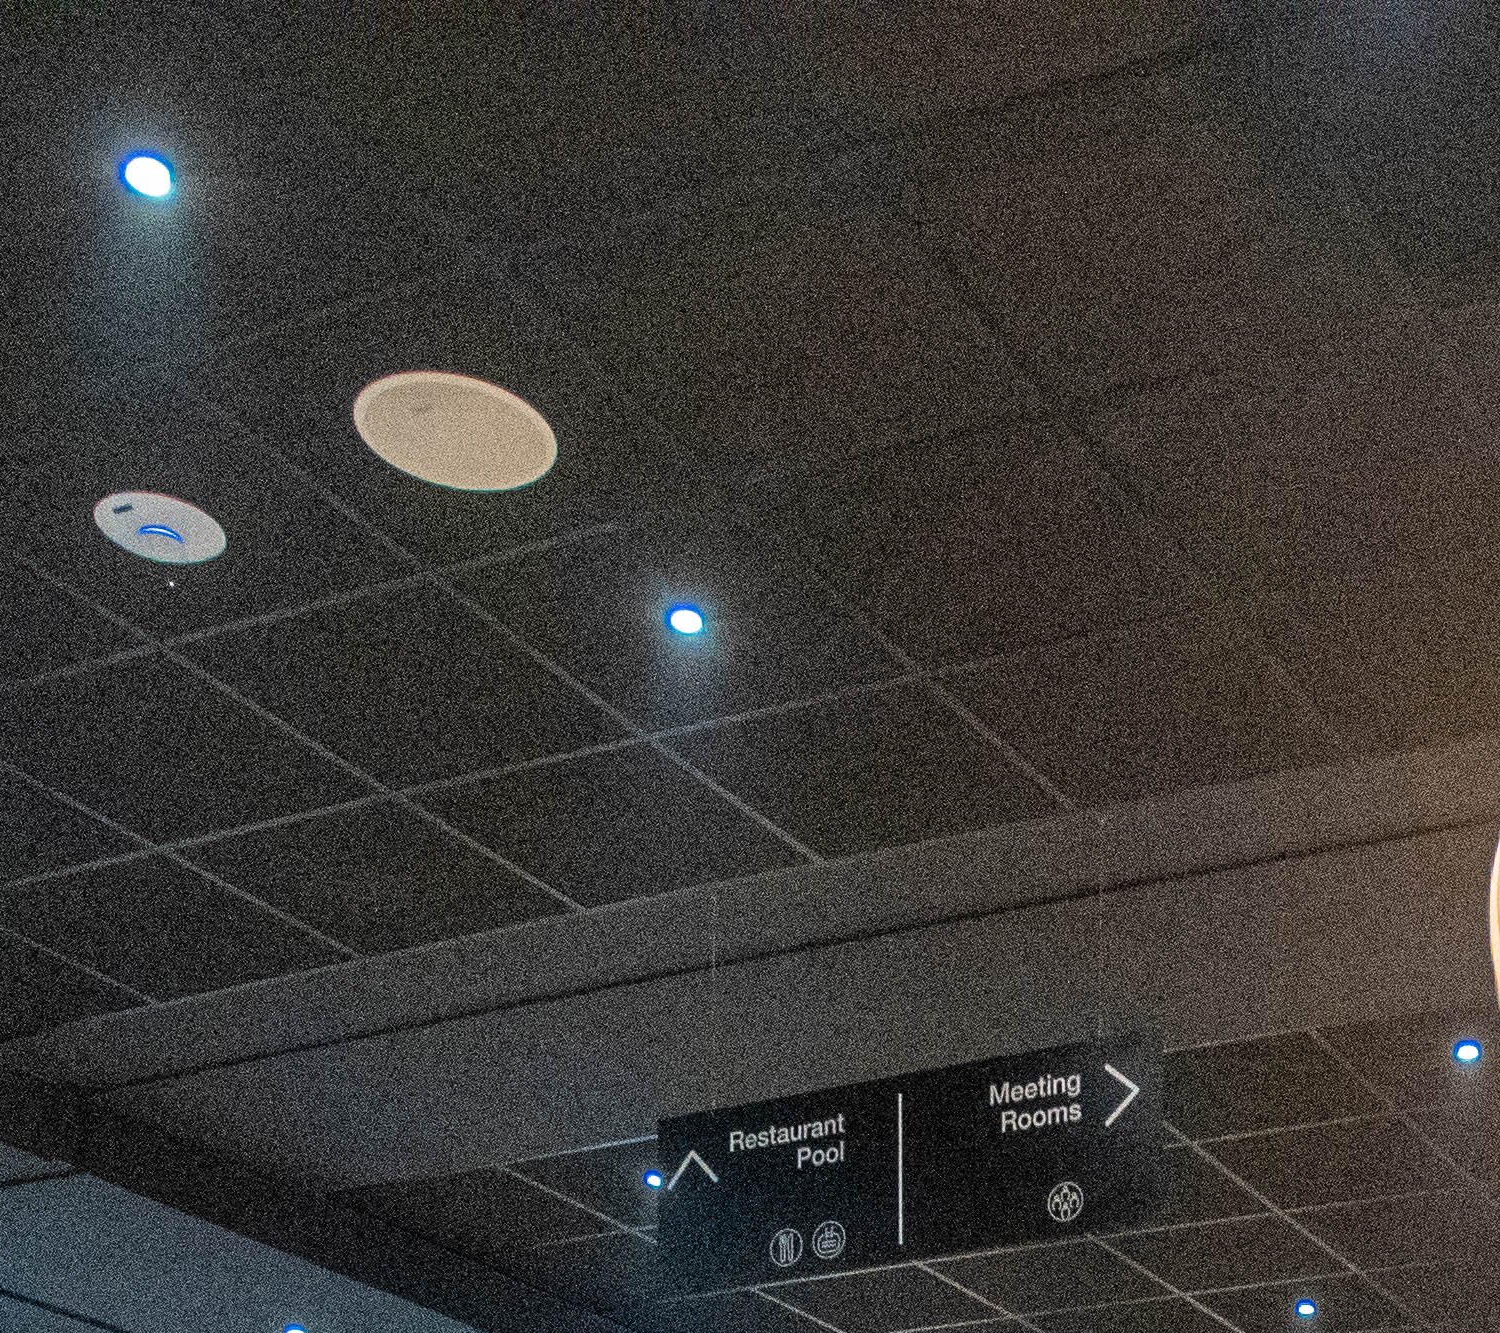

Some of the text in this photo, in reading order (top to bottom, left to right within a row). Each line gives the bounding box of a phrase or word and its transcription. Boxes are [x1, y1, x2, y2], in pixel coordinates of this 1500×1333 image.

[989, 1073, 1081, 1107] Meeting
[729, 1113, 845, 1152] Restaurant
[1001, 1103, 1082, 1133] Rooms
[797, 1141, 845, 1169] Pool
